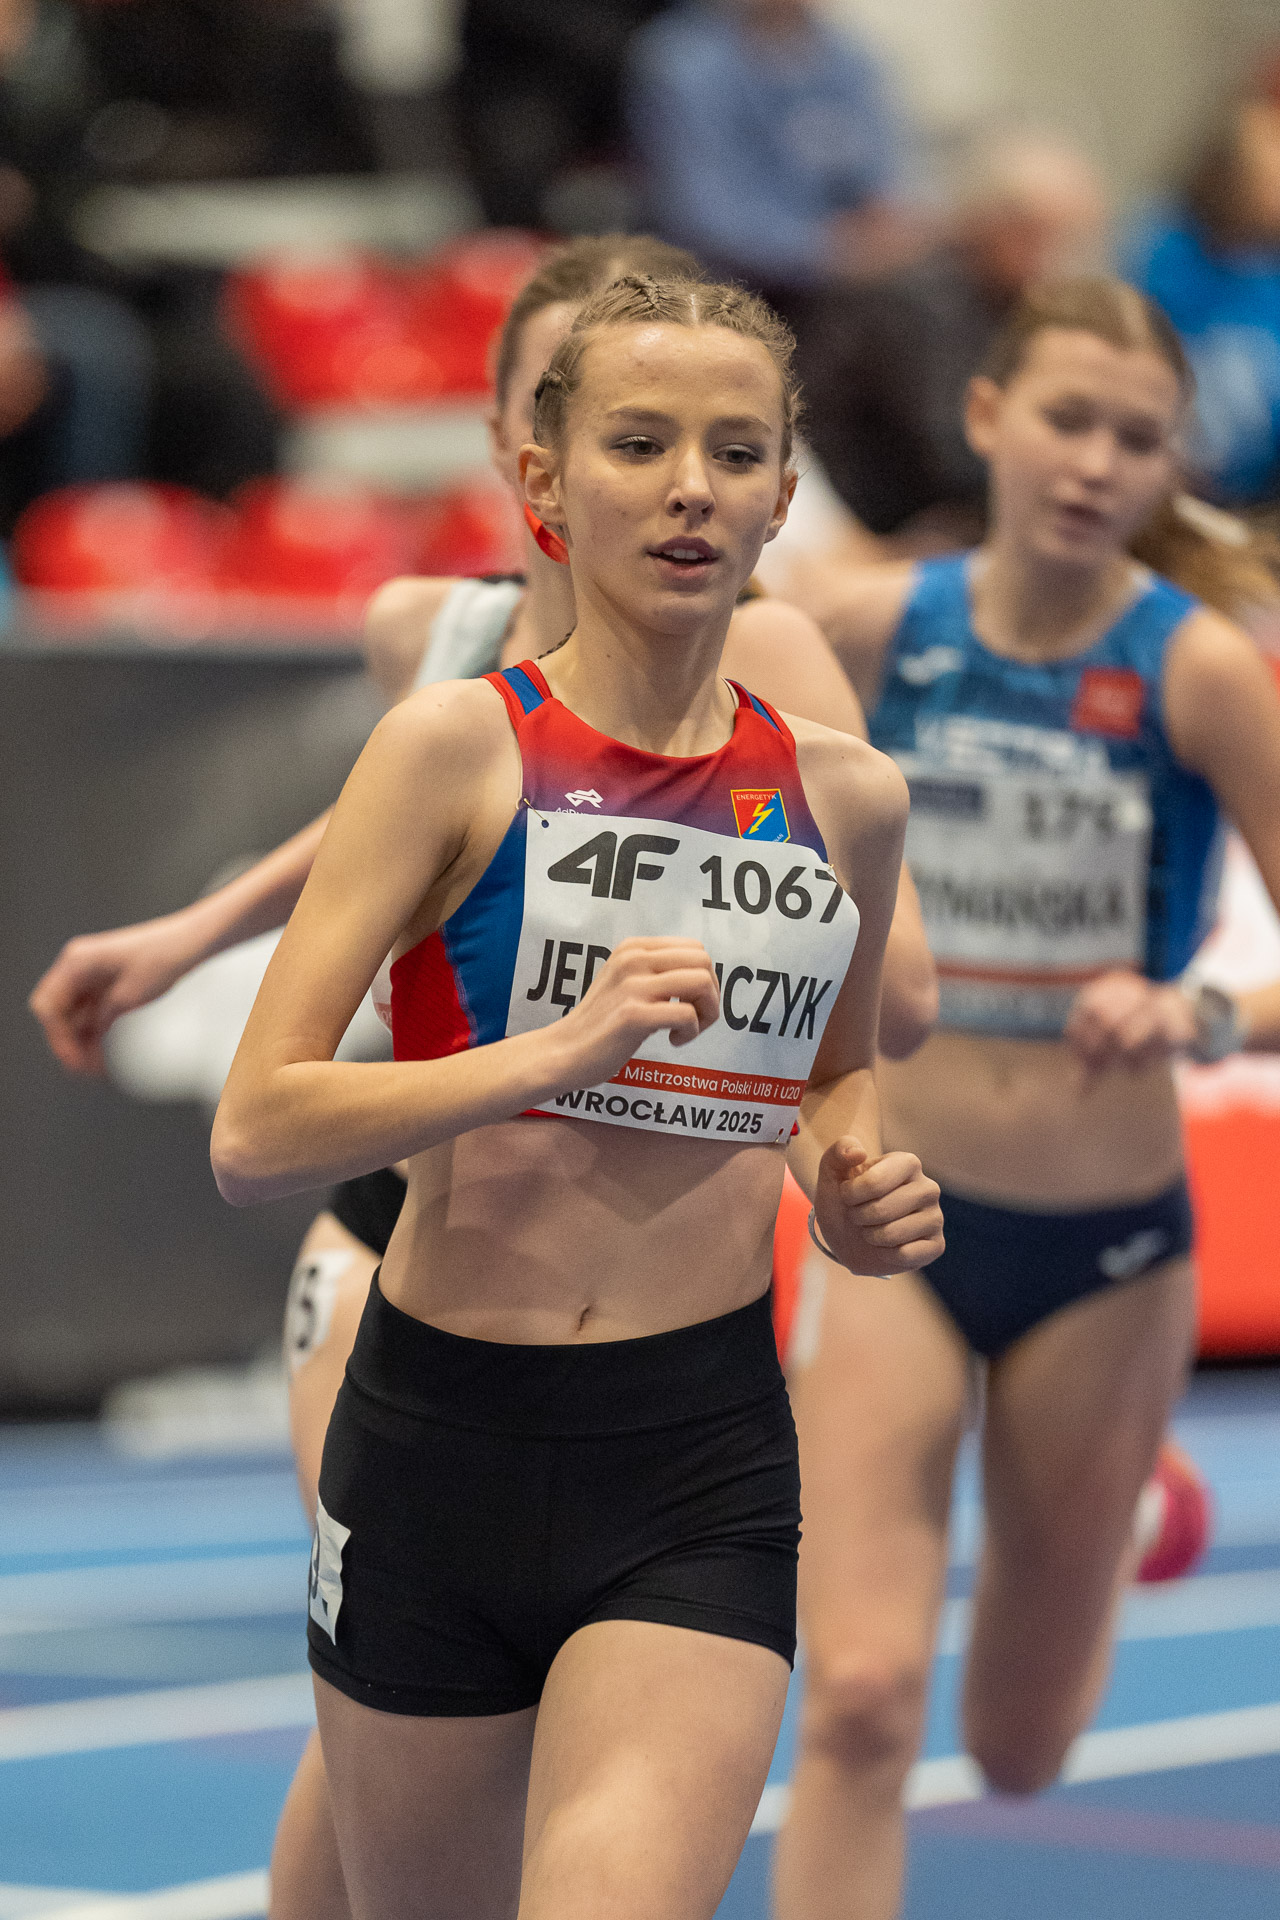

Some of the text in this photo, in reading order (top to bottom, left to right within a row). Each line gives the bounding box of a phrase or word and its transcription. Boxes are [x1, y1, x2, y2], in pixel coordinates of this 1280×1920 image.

[735, 793, 777, 801] ENERGETYK
[547, 831, 680, 901] 4F
[699, 855, 844, 924] 1067
[624, 1065, 718, 1091] Mistrzostwa
[721, 1079, 752, 1096] Polski
[753, 1083, 772, 1097] U18
[774, 1084, 780, 1099] i
[780, 1086, 801, 1100] U20
[555, 1089, 764, 1135] WROCŁAW 2025
